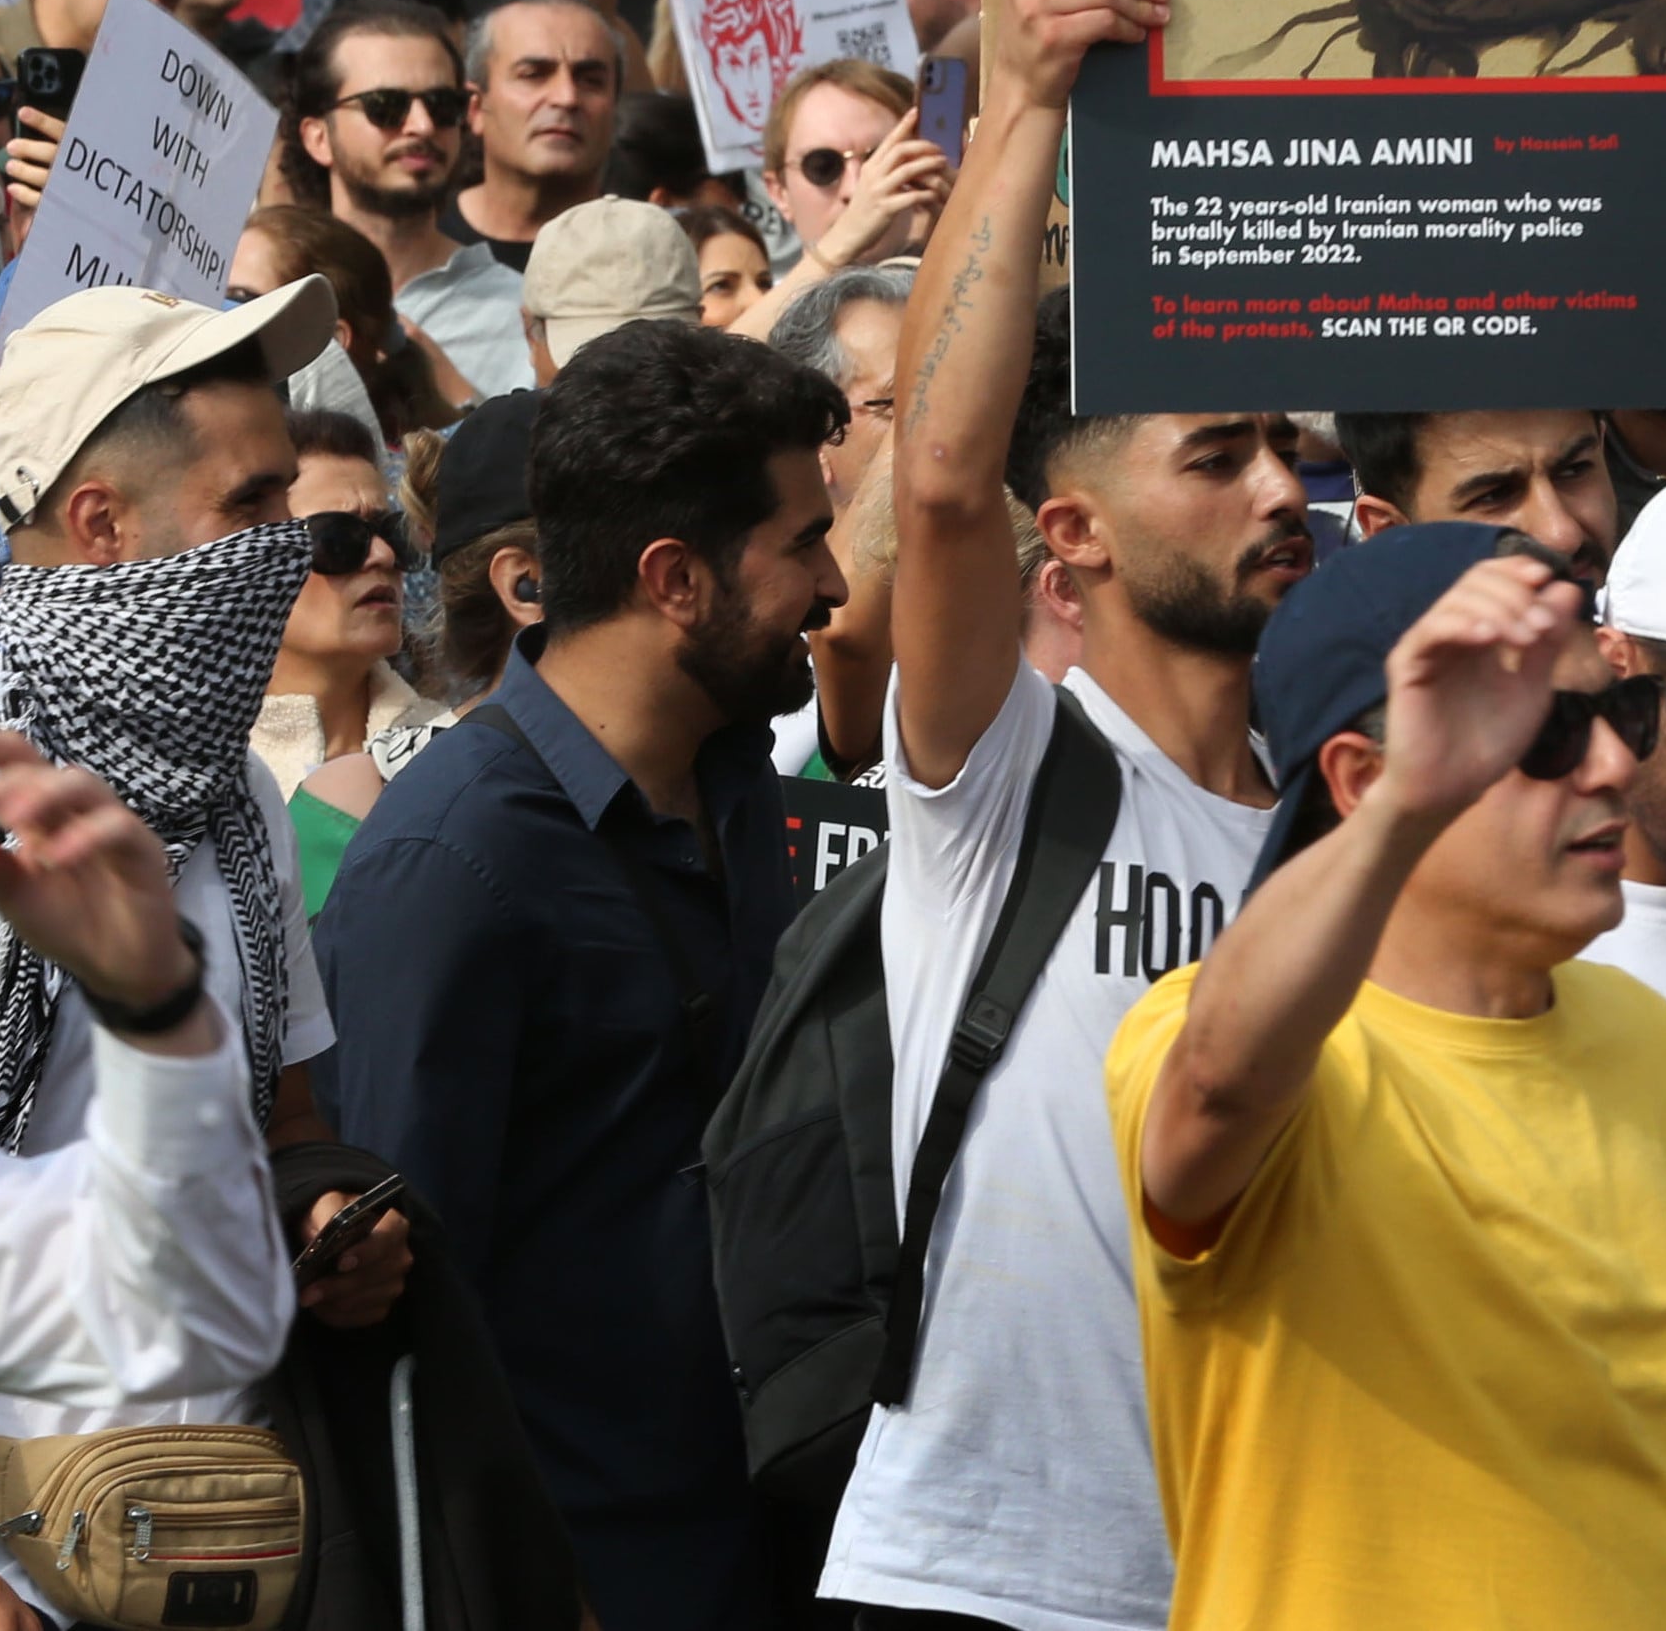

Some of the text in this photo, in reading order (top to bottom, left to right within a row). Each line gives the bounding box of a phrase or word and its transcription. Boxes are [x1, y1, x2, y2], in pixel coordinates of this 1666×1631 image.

[160, 48, 234, 132] DOWN
[152, 115, 211, 189] WITH
[1150, 140, 1274, 169] MAHSA
[1283, 139, 1361, 168] JINA
[1370, 137, 1473, 167] AMINI
[1494, 135, 1515, 154] by
[1520, 135, 1584, 152] Hossein
[64, 136, 227, 292] DICTATORSHIP!
[1150, 192, 1603, 221] The 22 years-old Iranian woman who was
[1150, 216, 1585, 246] brutally killed by Iranian morality police
[1151, 244, 1363, 271] in September 2022.
[1152, 290, 1638, 314] To learn more about Mahsa and other victims
[1152, 319, 1176, 339] of
[1180, 319, 1216, 339] the
[1321, 316, 1382, 338] SCAN
[1387, 316, 1428, 337] THE
[1432, 316, 1467, 337] QR
[1471, 314, 1538, 337] CODE.
